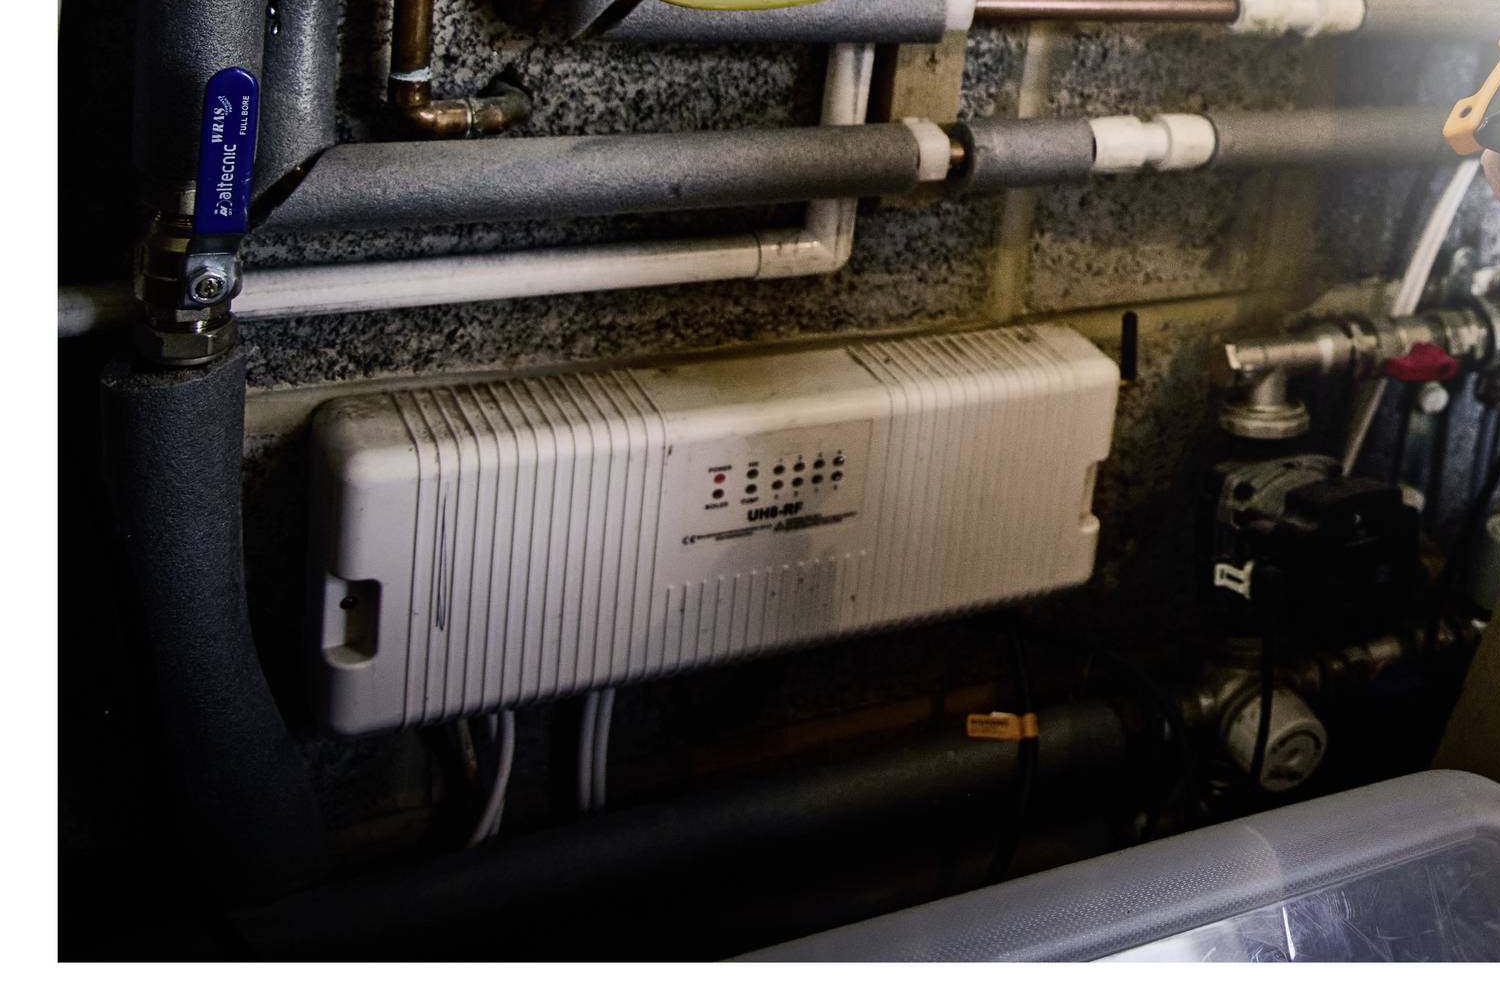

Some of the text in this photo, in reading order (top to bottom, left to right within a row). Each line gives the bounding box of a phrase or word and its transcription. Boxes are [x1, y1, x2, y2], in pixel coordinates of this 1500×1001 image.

[211, 107, 225, 143] WRAS
[239, 95, 250, 136] FULL BORE
[216, 144, 237, 200] altecnic
